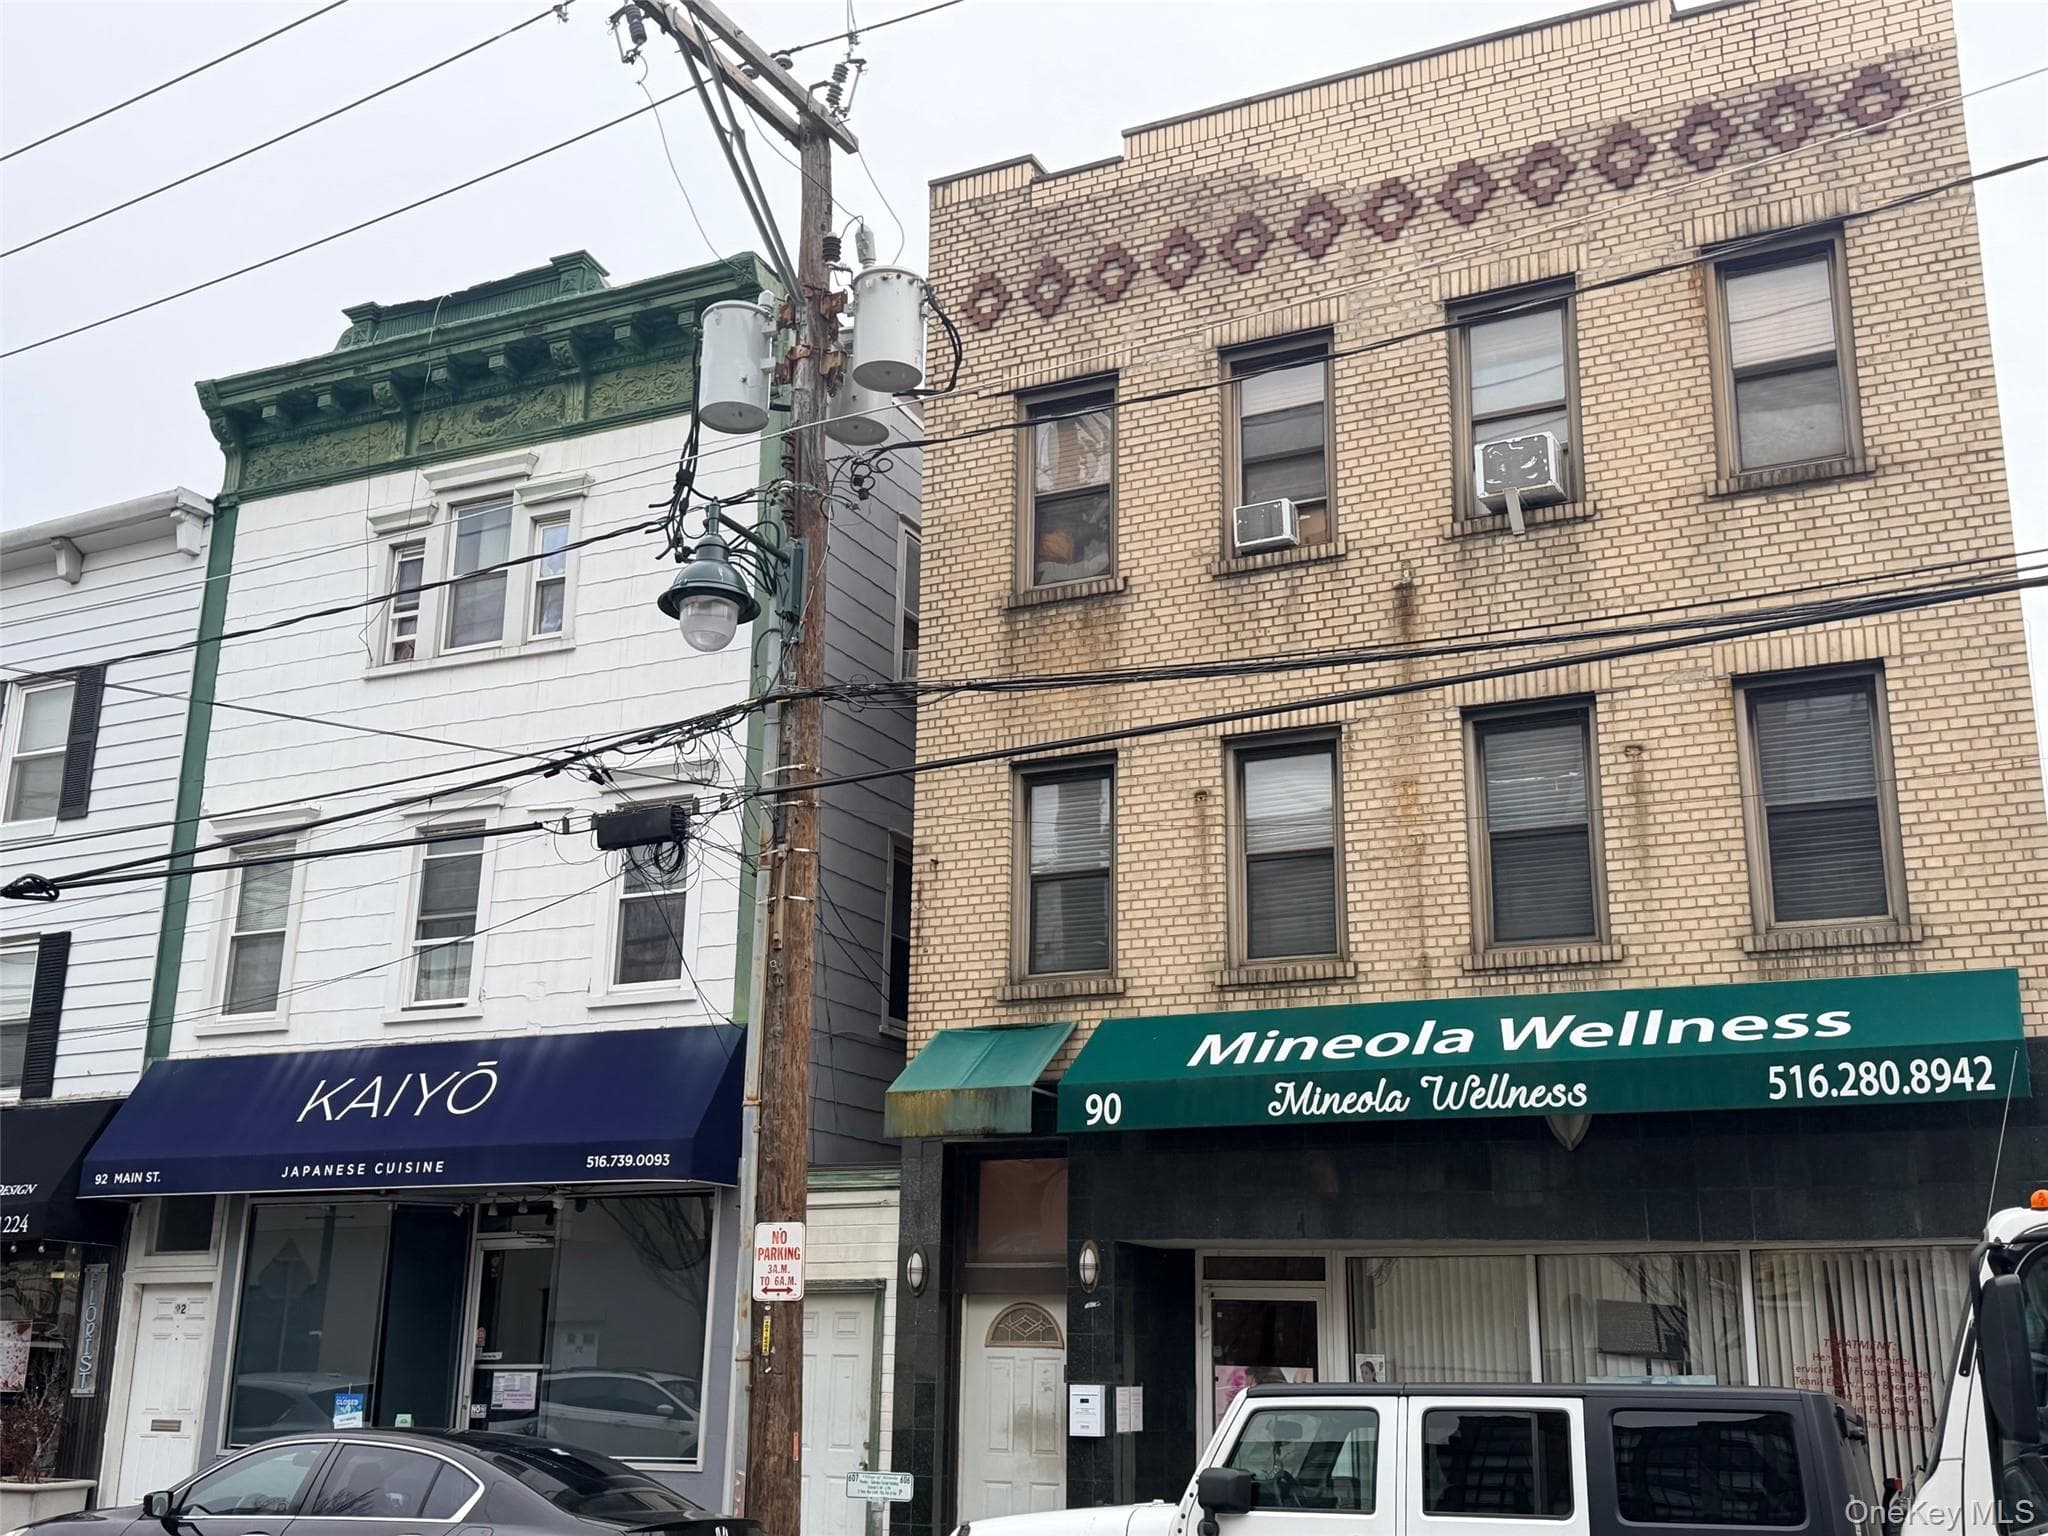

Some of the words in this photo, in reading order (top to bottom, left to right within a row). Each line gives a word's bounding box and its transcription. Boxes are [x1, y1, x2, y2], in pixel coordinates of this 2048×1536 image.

[1186, 1019, 1475, 1067] Mineola
[1500, 1009, 1852, 1051] Wellness
[1769, 1055, 1996, 1100] 516.280.8942
[296, 1060, 498, 1122] KAIYŌ
[1268, 1077, 1411, 1117] Mineola
[1420, 1073, 1588, 1111] Wellness
[1085, 1092, 1122, 1126] 90
[586, 1153, 670, 1168] 516.739.0093
[281, 1163, 366, 1178] JAPANESE
[374, 1161, 445, 1175] CUISINE
[94, 1173, 108, 1185] 92
[113, 1172, 143, 1184] MAIN
[145, 1171, 161, 1183] ST.
[0, 1184, 38, 1196] DESIGN
[771, 1230, 788, 1245] NO
[757, 1247, 801, 1261] PARKING
[760, 1276, 770, 1286] TO
[1793, 1365, 1826, 1375] ervical
